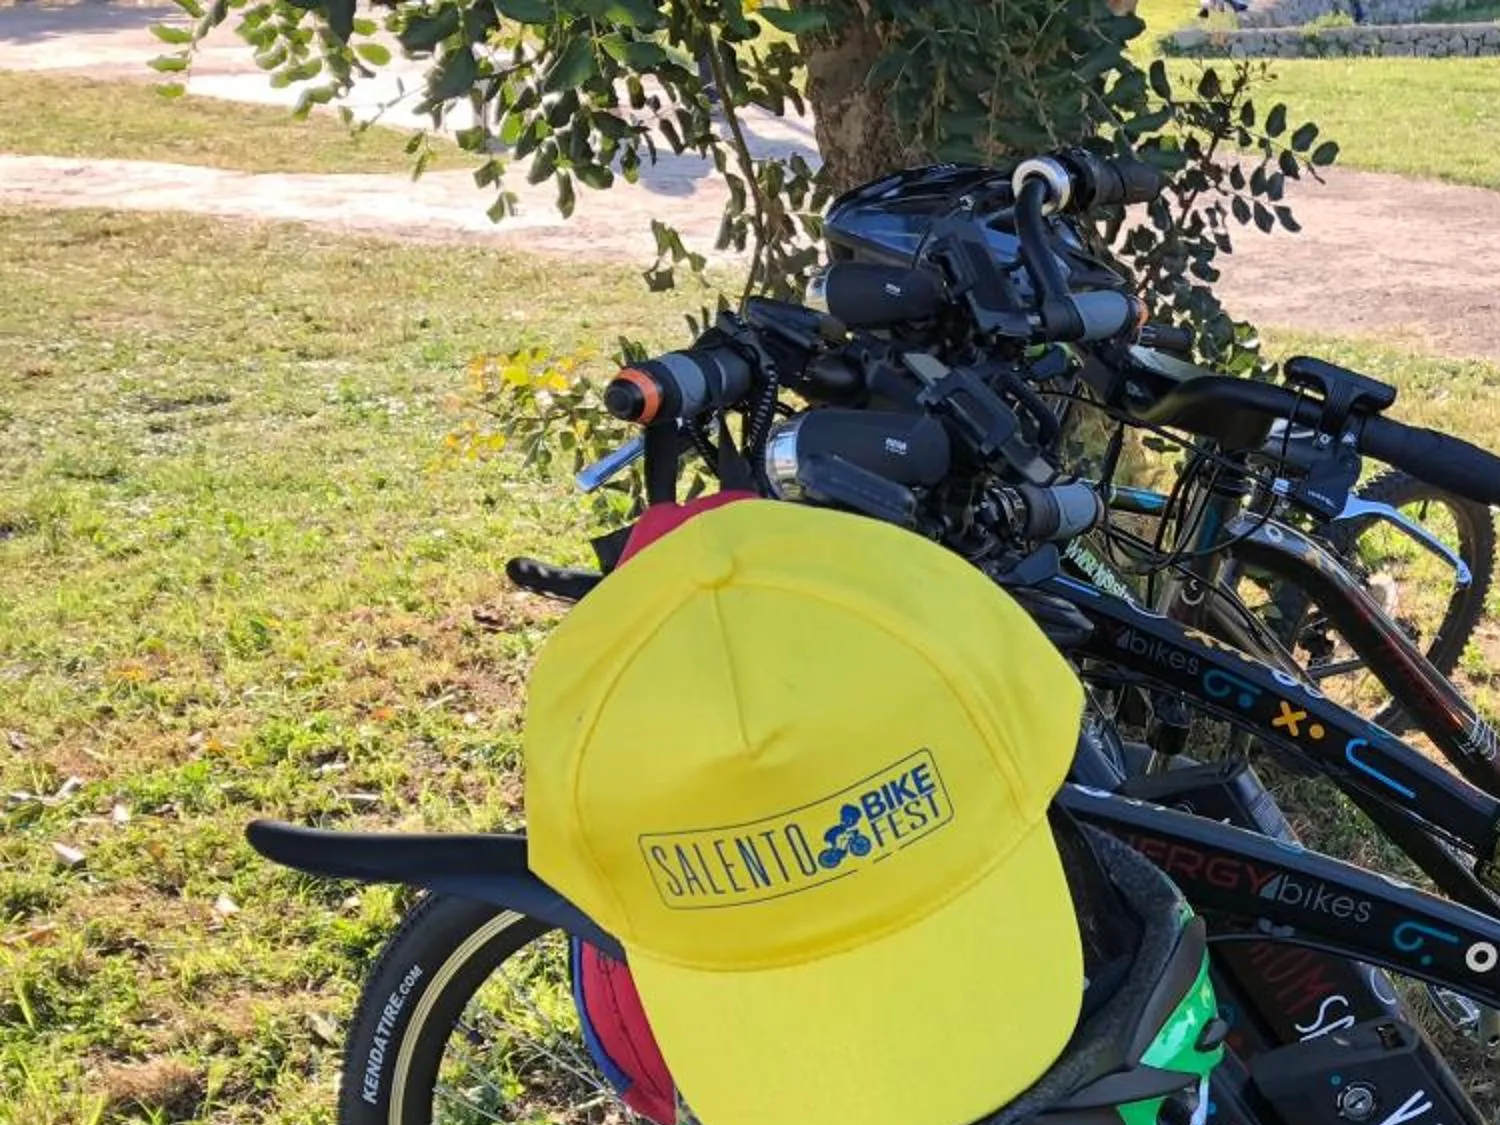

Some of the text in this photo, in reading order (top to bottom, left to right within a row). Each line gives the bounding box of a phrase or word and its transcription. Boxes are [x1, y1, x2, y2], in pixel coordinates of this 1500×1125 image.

[1130, 629, 1199, 675] bikes
[860, 762, 937, 821] BIKE
[870, 791, 943, 849] FEST
[650, 822, 814, 898] SALENTO
[1279, 876, 1372, 923] bikes
[361, 964, 424, 1105] KENDATIRE.COM
